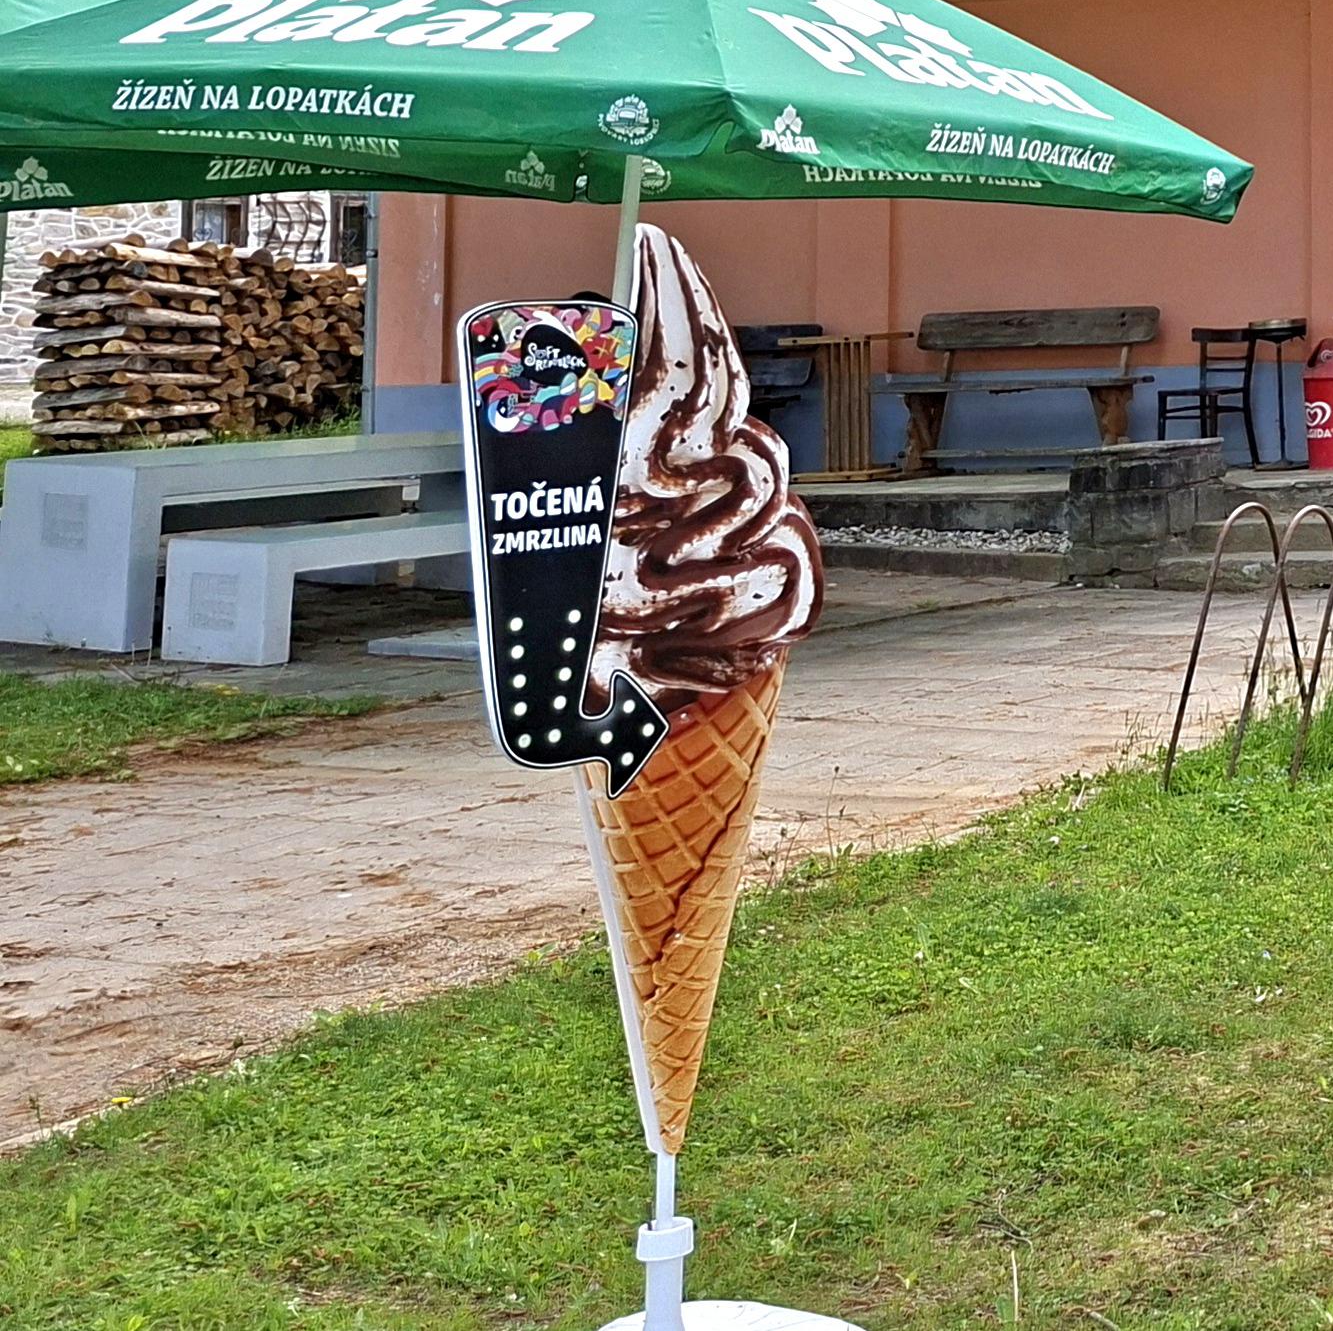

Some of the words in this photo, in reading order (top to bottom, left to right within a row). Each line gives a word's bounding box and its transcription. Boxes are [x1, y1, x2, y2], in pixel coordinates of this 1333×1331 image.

[748, 6, 1114, 120] Platan
[112, 79, 196, 110] ŽÍZEŇ
[201, 86, 240, 110] NA
[248, 84, 415, 118] LOPATKÁCH
[756, 128, 821, 155] Platan
[926, 123, 985, 155] ŽÍZEŇ
[988, 134, 1013, 158] NA
[1017, 137, 1115, 174] LOPATKÁCH
[490, 476, 605, 522] TOČENÁ
[492, 523, 602, 555] ZMRZLINA
